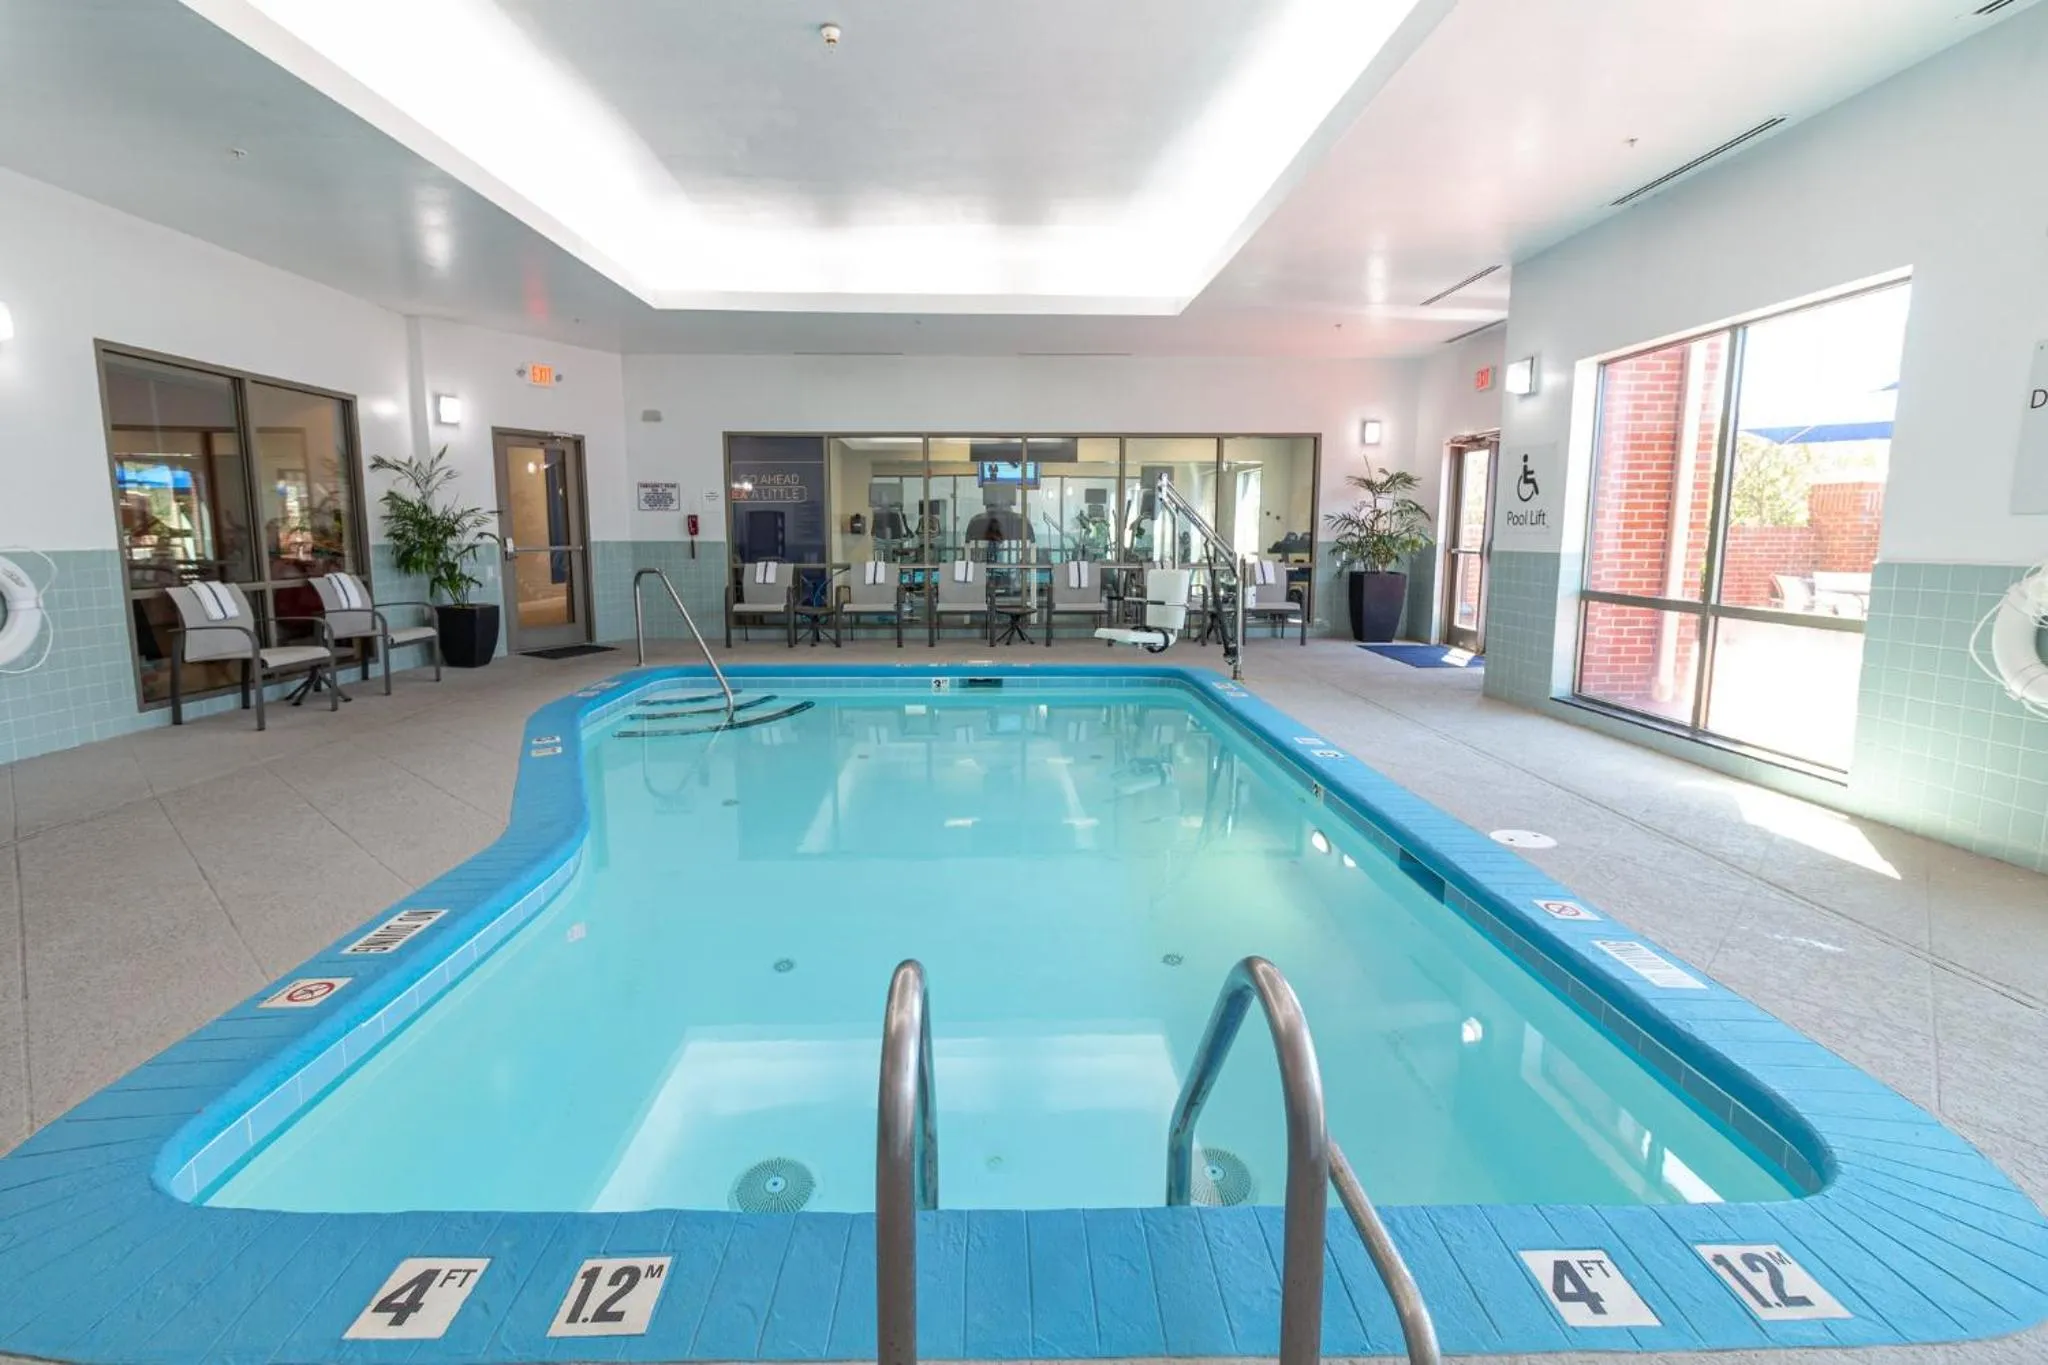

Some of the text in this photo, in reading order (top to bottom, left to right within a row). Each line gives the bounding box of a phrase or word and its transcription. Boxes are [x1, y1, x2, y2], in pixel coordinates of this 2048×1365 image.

[760, 473, 800, 485] AHEAD
[761, 488, 800, 500] LITTLE
[1506, 509, 1546, 526] Pool Lift
[371, 1268, 478, 1327] 4 FT
[565, 1264, 665, 1325] 1.2 M
[1552, 1259, 1611, 1316] 4 FT
[1711, 1251, 1815, 1310] 1.2 M
